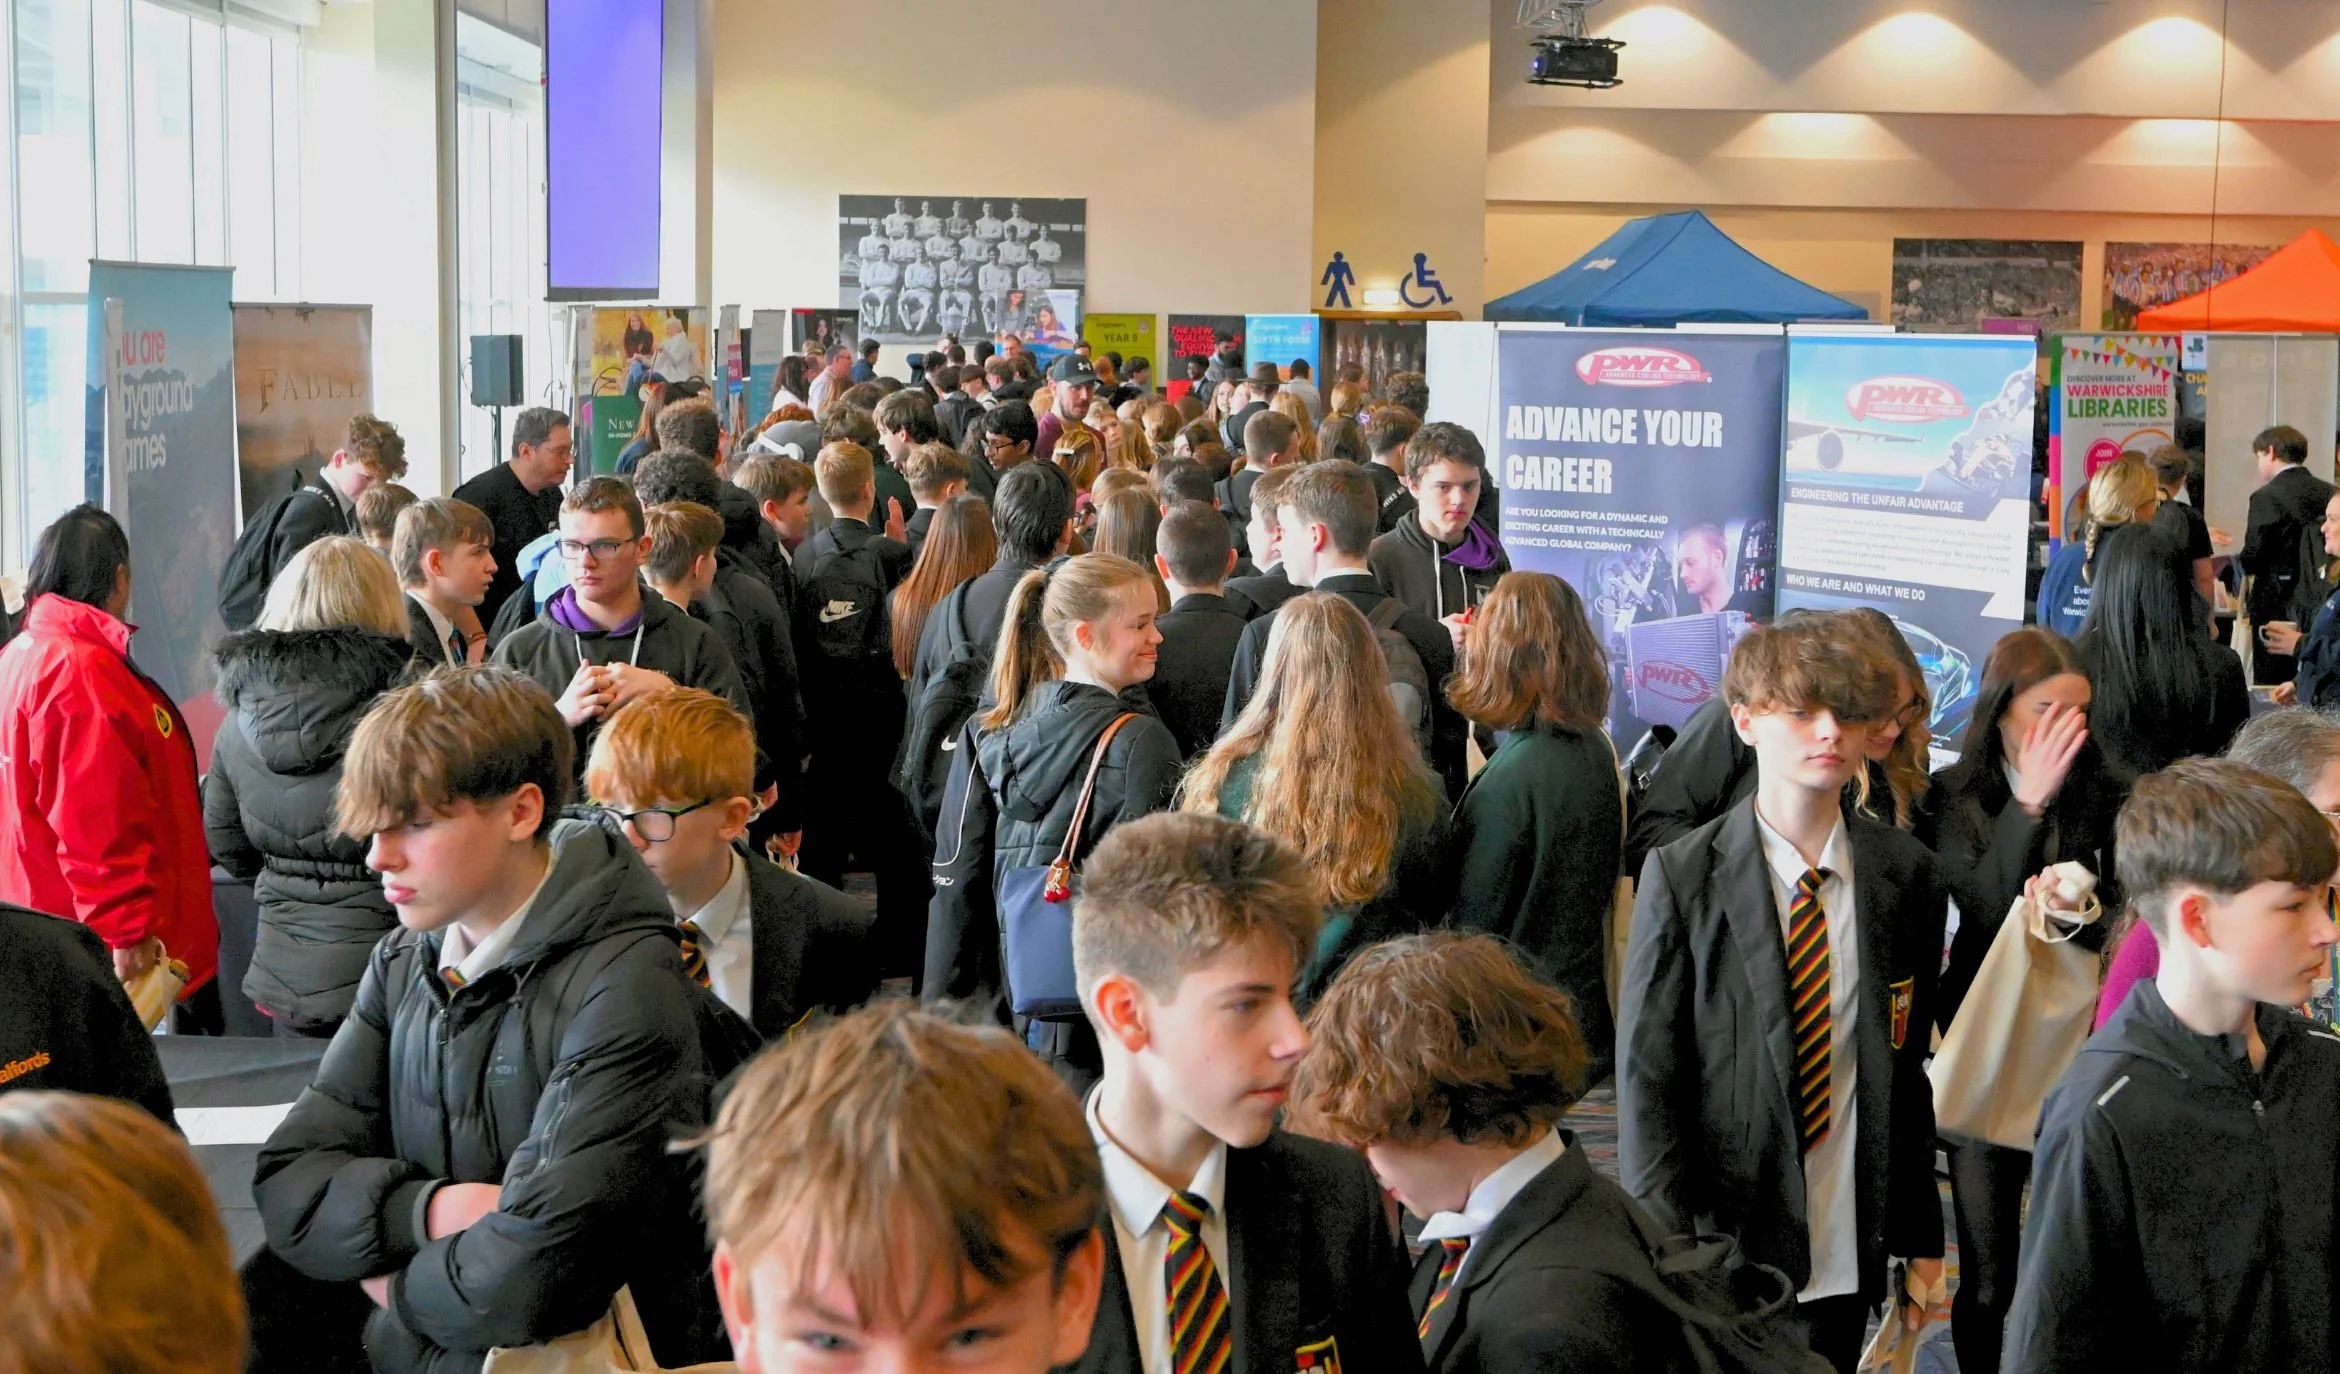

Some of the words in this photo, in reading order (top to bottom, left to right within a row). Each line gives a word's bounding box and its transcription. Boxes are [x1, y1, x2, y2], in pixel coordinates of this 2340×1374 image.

[1103, 333, 1129, 343] YEAR
[1580, 354, 1682, 385] PWR
[2066, 375, 2103, 383] DISCOVER
[2105, 375, 2125, 383] MORE
[2127, 375, 2136, 383] AT
[258, 368, 363, 414] FABLE
[2067, 383, 2169, 397] WARWICKSHIRE
[1852, 384, 1946, 422] PWR
[2067, 398, 2168, 418] LIBRARIES
[1506, 405, 1637, 444] ADVANCE
[1643, 409, 1723, 448] YOUR
[122, 432, 166, 472] ames
[1506, 454, 1612, 494] CAREER
[1791, 487, 1849, 503] ENGINEERING
[1851, 492, 1869, 505] THE
[1872, 494, 1906, 508] UNFAIR
[1908, 498, 1964, 513] ADVANTAGE
[1505, 508, 1518, 516] ARE
[1520, 508, 1539, 517] YOU
[1540, 509, 1580, 519] LOOKING
[1581, 511, 1599, 520] FOR
[1607, 512, 1648, 523] DYNAMIC
[1649, 515, 1669, 524] AND
[1504, 521, 1540, 531] EXCITING
[1541, 523, 1575, 534] CAREER
[1576, 526, 1600, 535] WITH
[1608, 527, 1665, 539] TECHNICALLY
[1504, 536, 1548, 547] ADVANCED
[1549, 539, 1583, 549] GLOBAL
[1584, 540, 1632, 552] COMPANY?
[1786, 573, 1805, 587] WHO
[1806, 576, 1821, 588] WE
[1821, 577, 1842, 590] ARE
[1843, 579, 1863, 593] AND
[1865, 583, 1892, 598] WHAT
[1893, 586, 1910, 600] WE
[1911, 589, 1926, 601] DO
[2073, 585, 2091, 595] Ever
[826, 599, 856, 614] NIKE
[2062, 607, 2086, 617] Warwic
[0, 1051, 51, 1084] alfords
